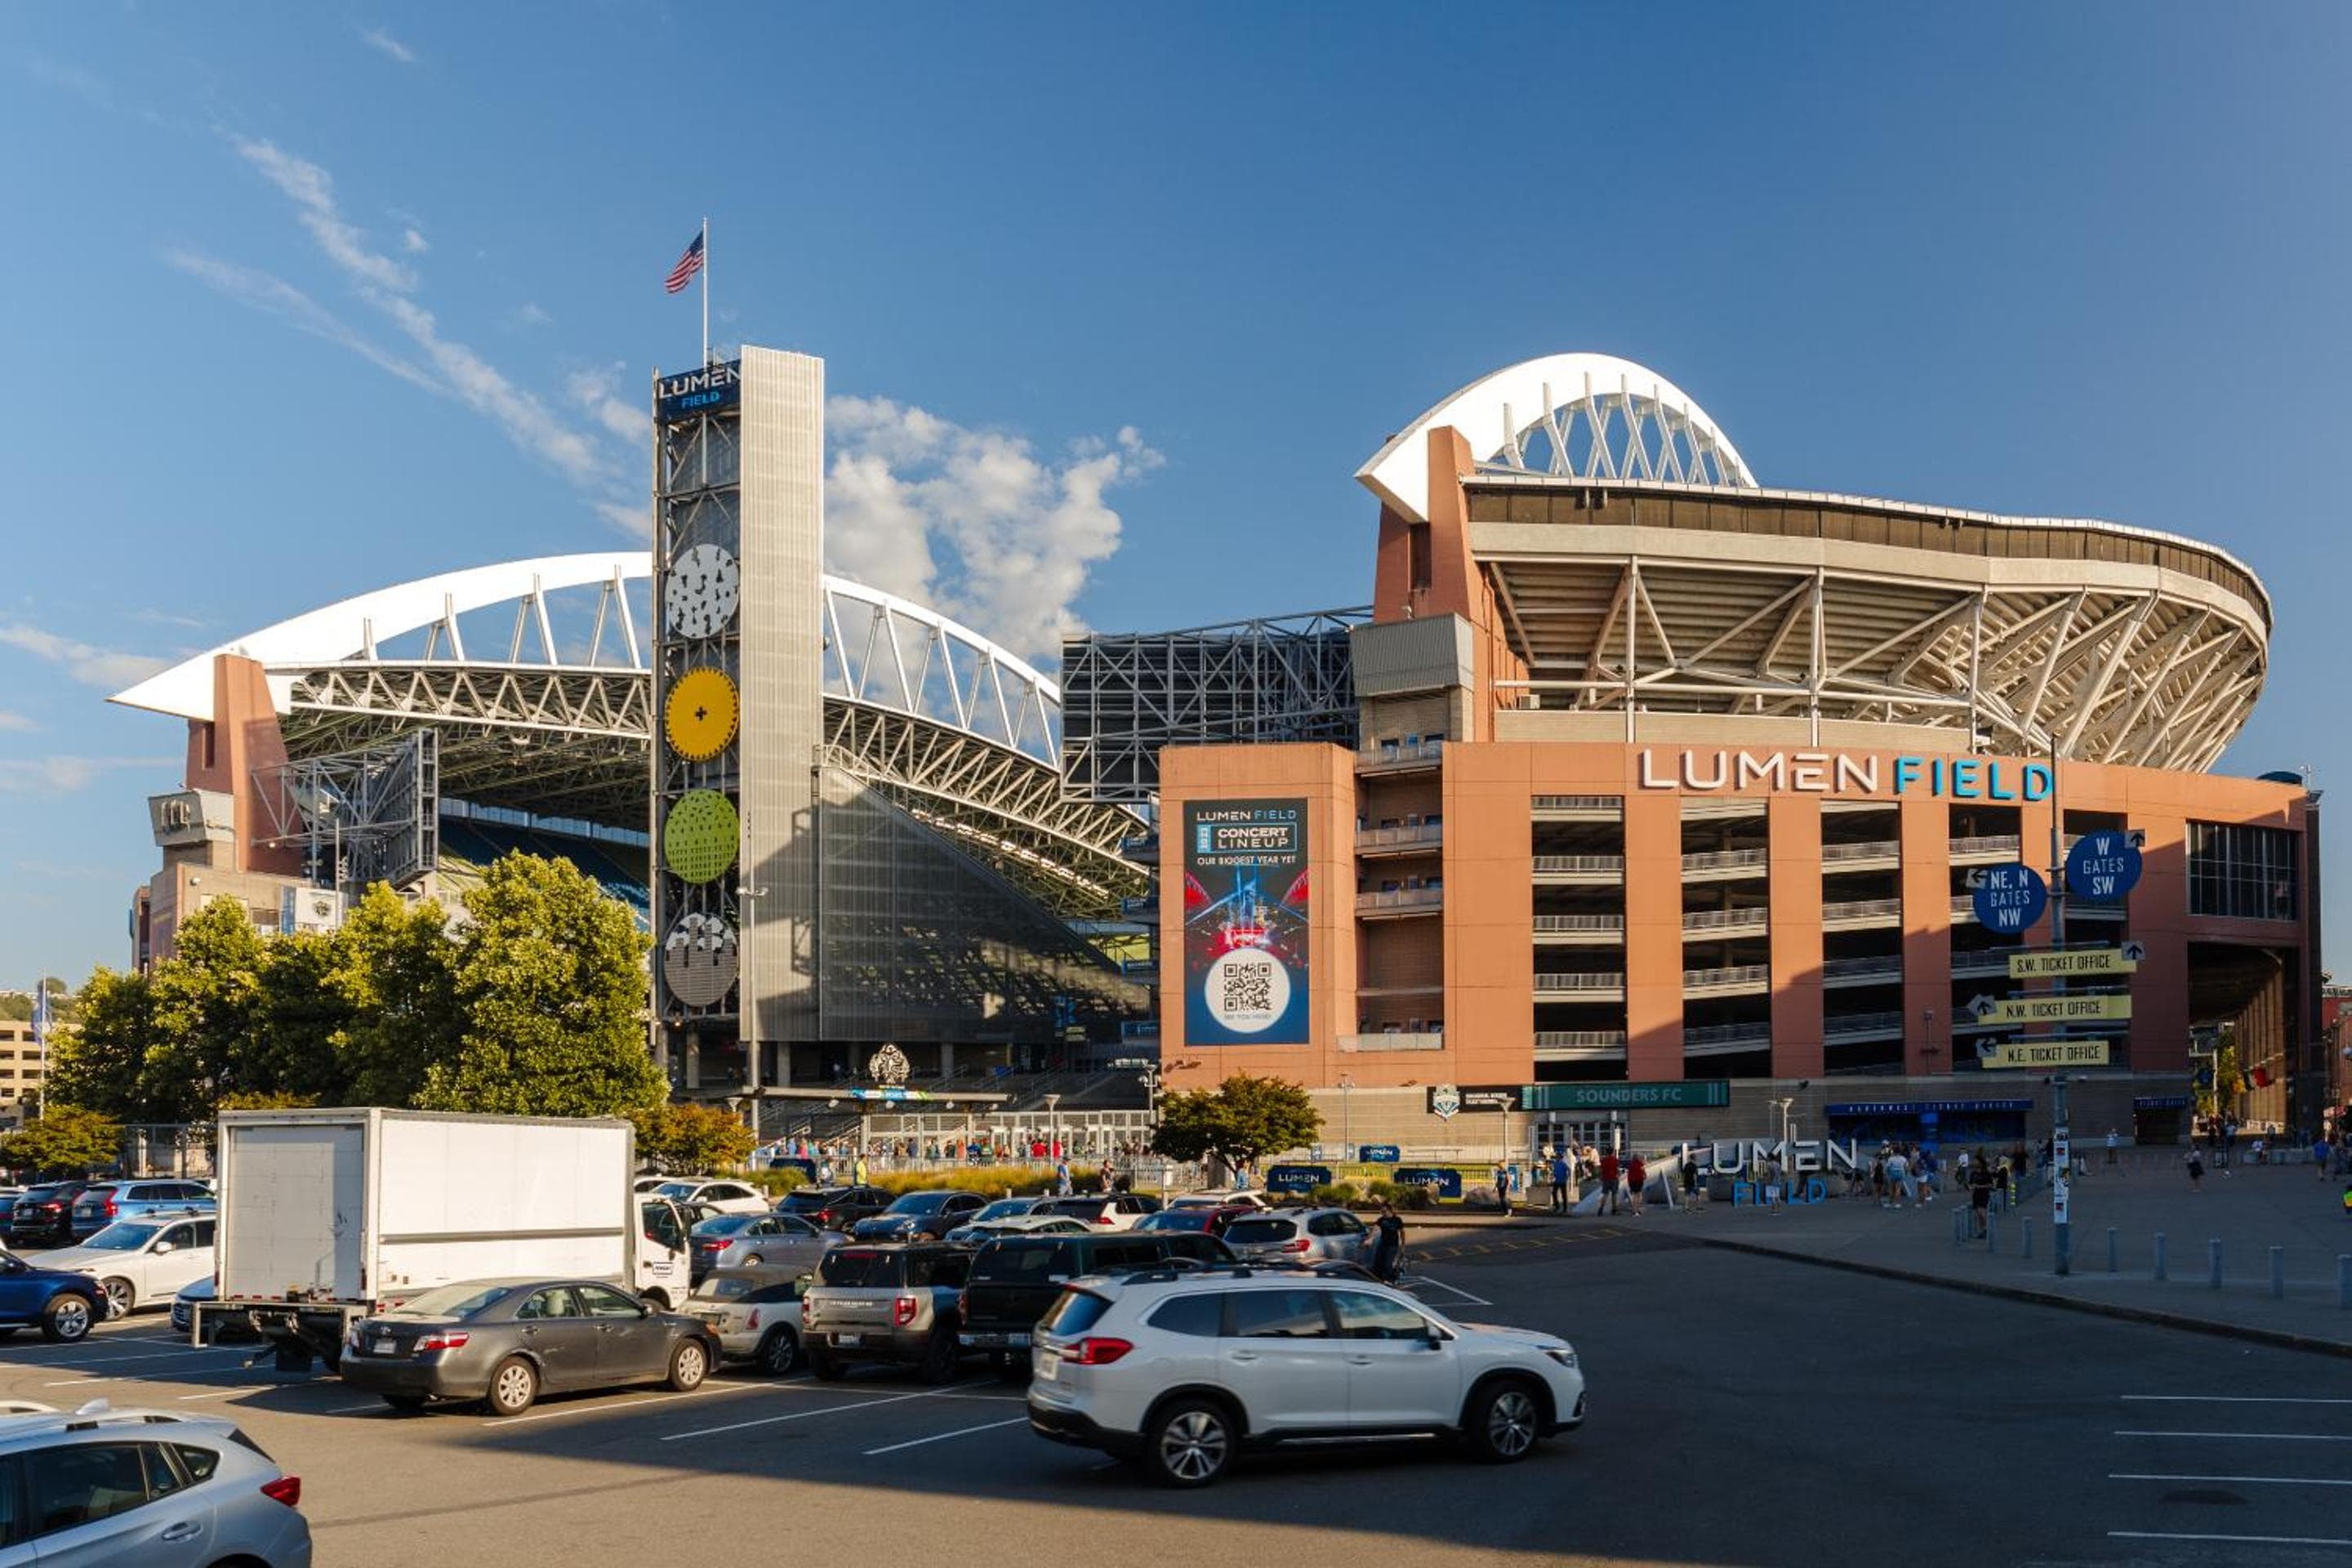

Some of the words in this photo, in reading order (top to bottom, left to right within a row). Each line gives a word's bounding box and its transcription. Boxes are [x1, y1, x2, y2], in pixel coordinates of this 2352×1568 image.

[659, 368, 741, 399] LUMEN
[681, 391, 720, 408] FIELD
[1641, 748, 1878, 792] LUMEN
[1894, 754, 2054, 803] FIELD
[1196, 810, 1251, 821] LUMEN
[1254, 809, 1296, 819] FIELD
[1218, 827, 1289, 838] CONCERT
[1218, 838, 1288, 849] LINEUP
[2096, 837, 2110, 856] W
[1197, 857, 1216, 866] OUR
[1218, 856, 1255, 865] BIGGEST
[1257, 855, 1279, 864] YEAR
[2083, 857, 2124, 875] GATES
[2019, 869, 2029, 888] N
[2092, 876, 2114, 896] SW
[1990, 890, 2030, 907] GATES
[1998, 907, 2021, 927] NW
[2017, 959, 2037, 973] S.W.
[2042, 956, 2074, 971] TICKET
[2078, 955, 2111, 969] OFFICE
[2007, 1004, 2027, 1018] N.W.
[2032, 1003, 2064, 1017] TICKET
[2068, 1001, 2102, 1015] OFFICE
[2030, 1047, 2063, 1062] TICKET
[2068, 1046, 2100, 1061] OFFICE
[1576, 1088, 1659, 1103] SOUNDERS
[1662, 1088, 1682, 1101] FC
[1682, 1138, 1858, 1174] LUMEN
[1278, 1174, 1320, 1183] LUMEN
[1732, 1177, 1829, 1208] FILD
